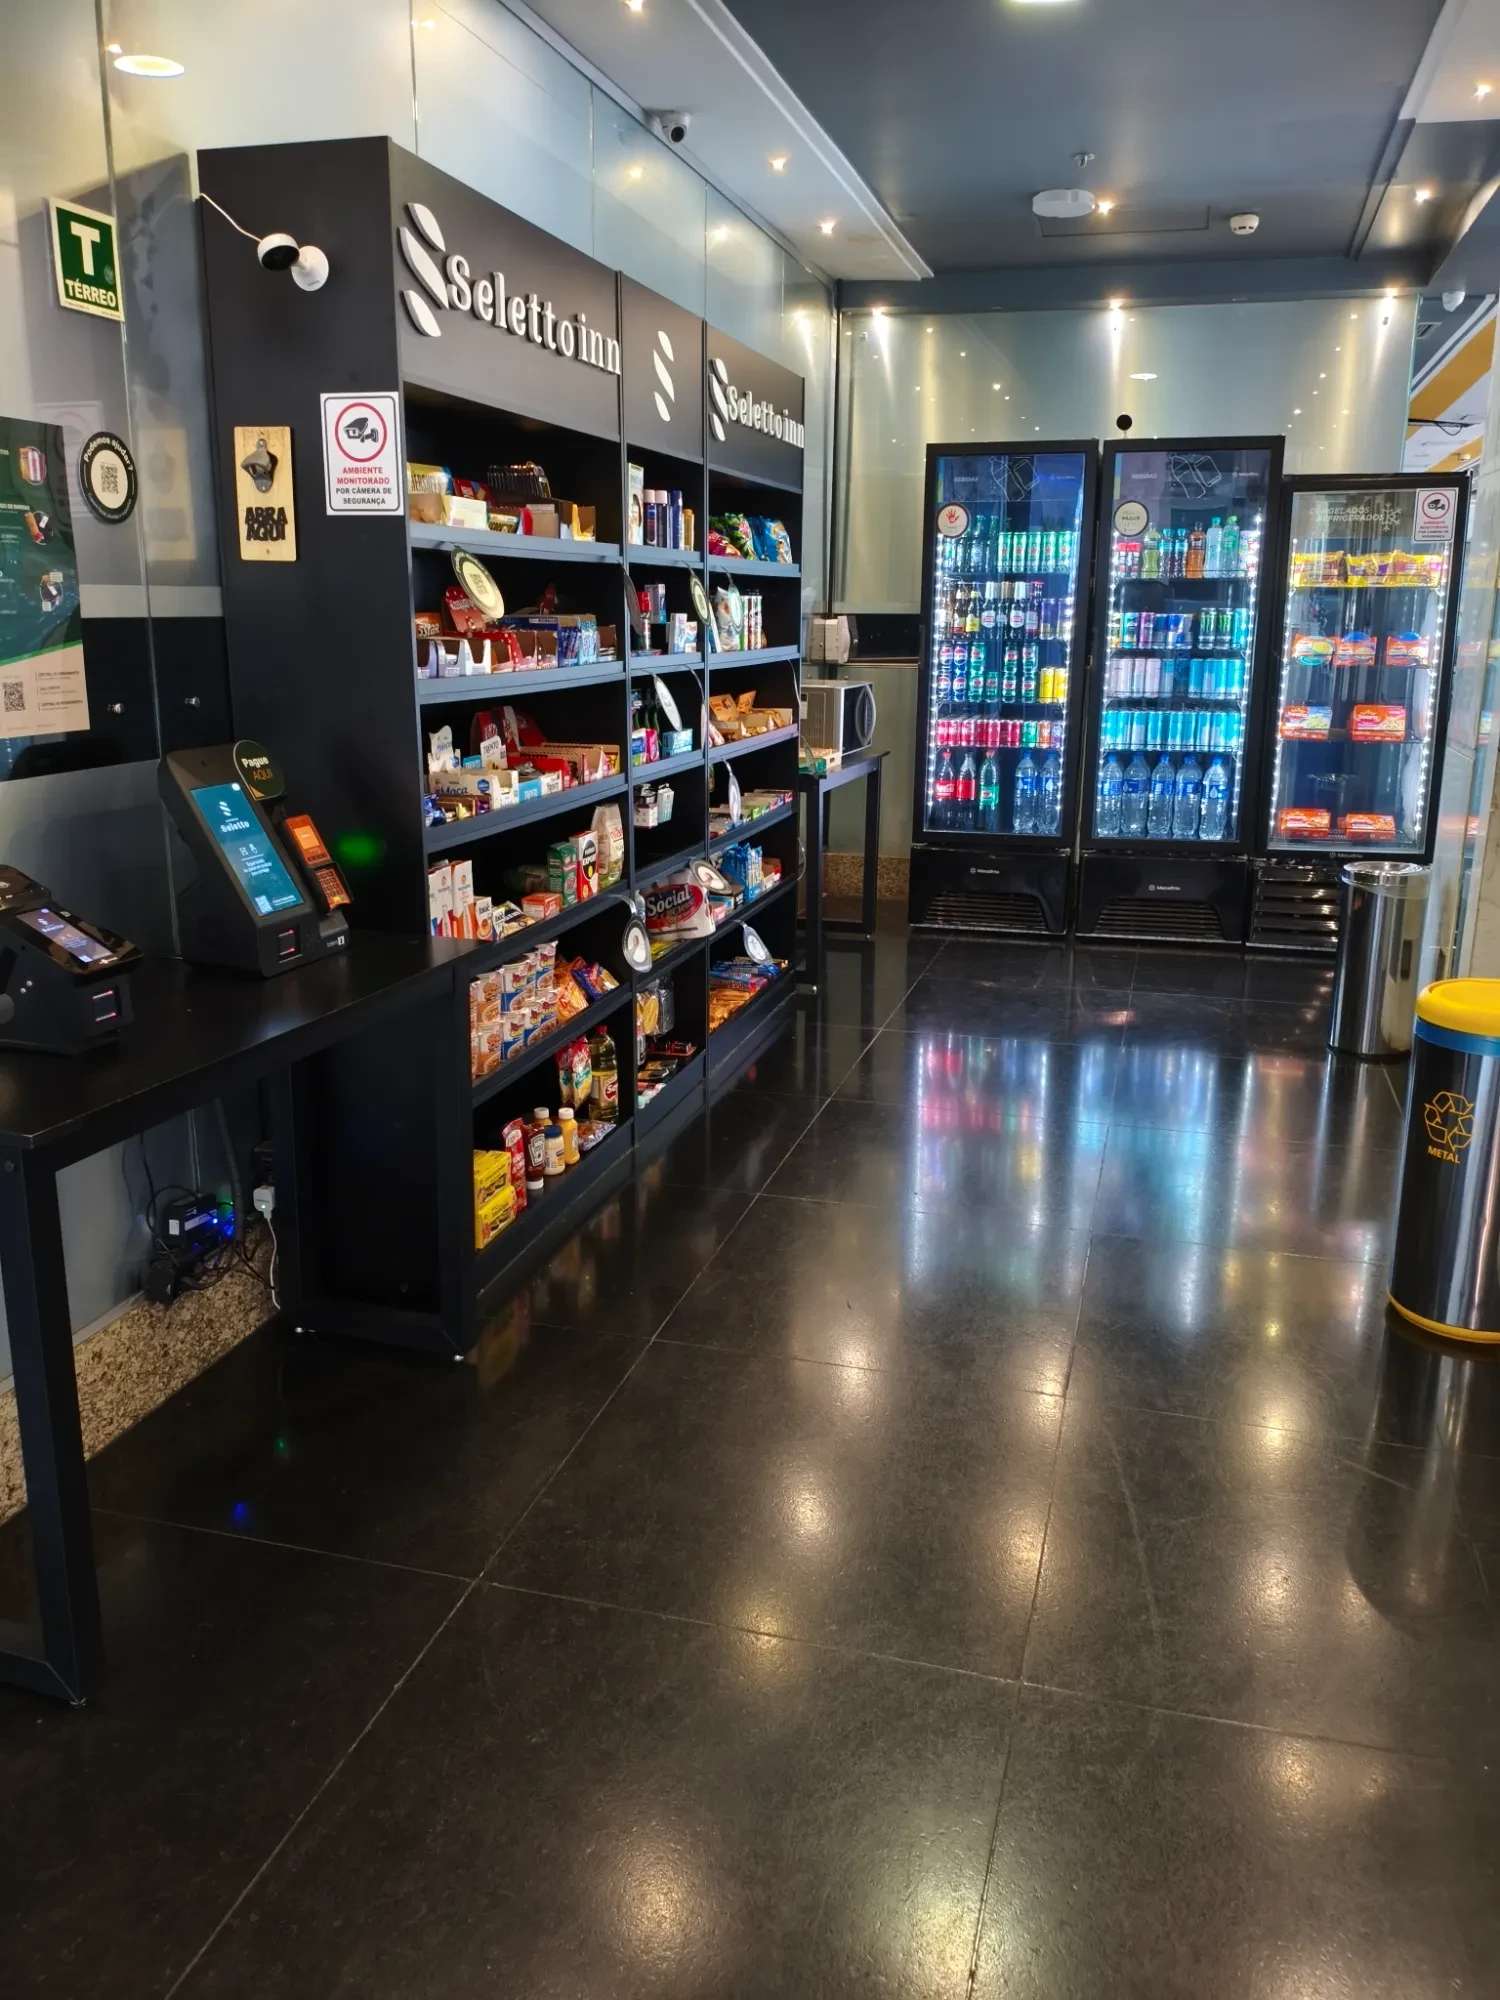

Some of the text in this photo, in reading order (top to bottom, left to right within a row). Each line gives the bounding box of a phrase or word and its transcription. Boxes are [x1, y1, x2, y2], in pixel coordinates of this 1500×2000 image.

[70, 220, 101, 277] T
[65, 278, 117, 308] TÉRREO
[83, 436, 134, 471] Podemos ajudar?
[342, 466, 384, 475] AMBIENTE
[336, 476, 390, 485] MONITORADO
[335, 487, 350, 495] POR
[351, 486, 381, 495] CÂMERA
[342, 497, 386, 506] SEGURANÇA
[245, 507, 288, 525] ABRA
[1308, 506, 1370, 516] CONGELADOS
[246, 522, 286, 541] AQUI
[241, 756, 269, 768] Pague
[253, 768, 274, 781] AQUI
[220, 820, 250, 833] Seletto
[647, 883, 691, 918] Social
[1427, 1145, 1461, 1164] METAL
